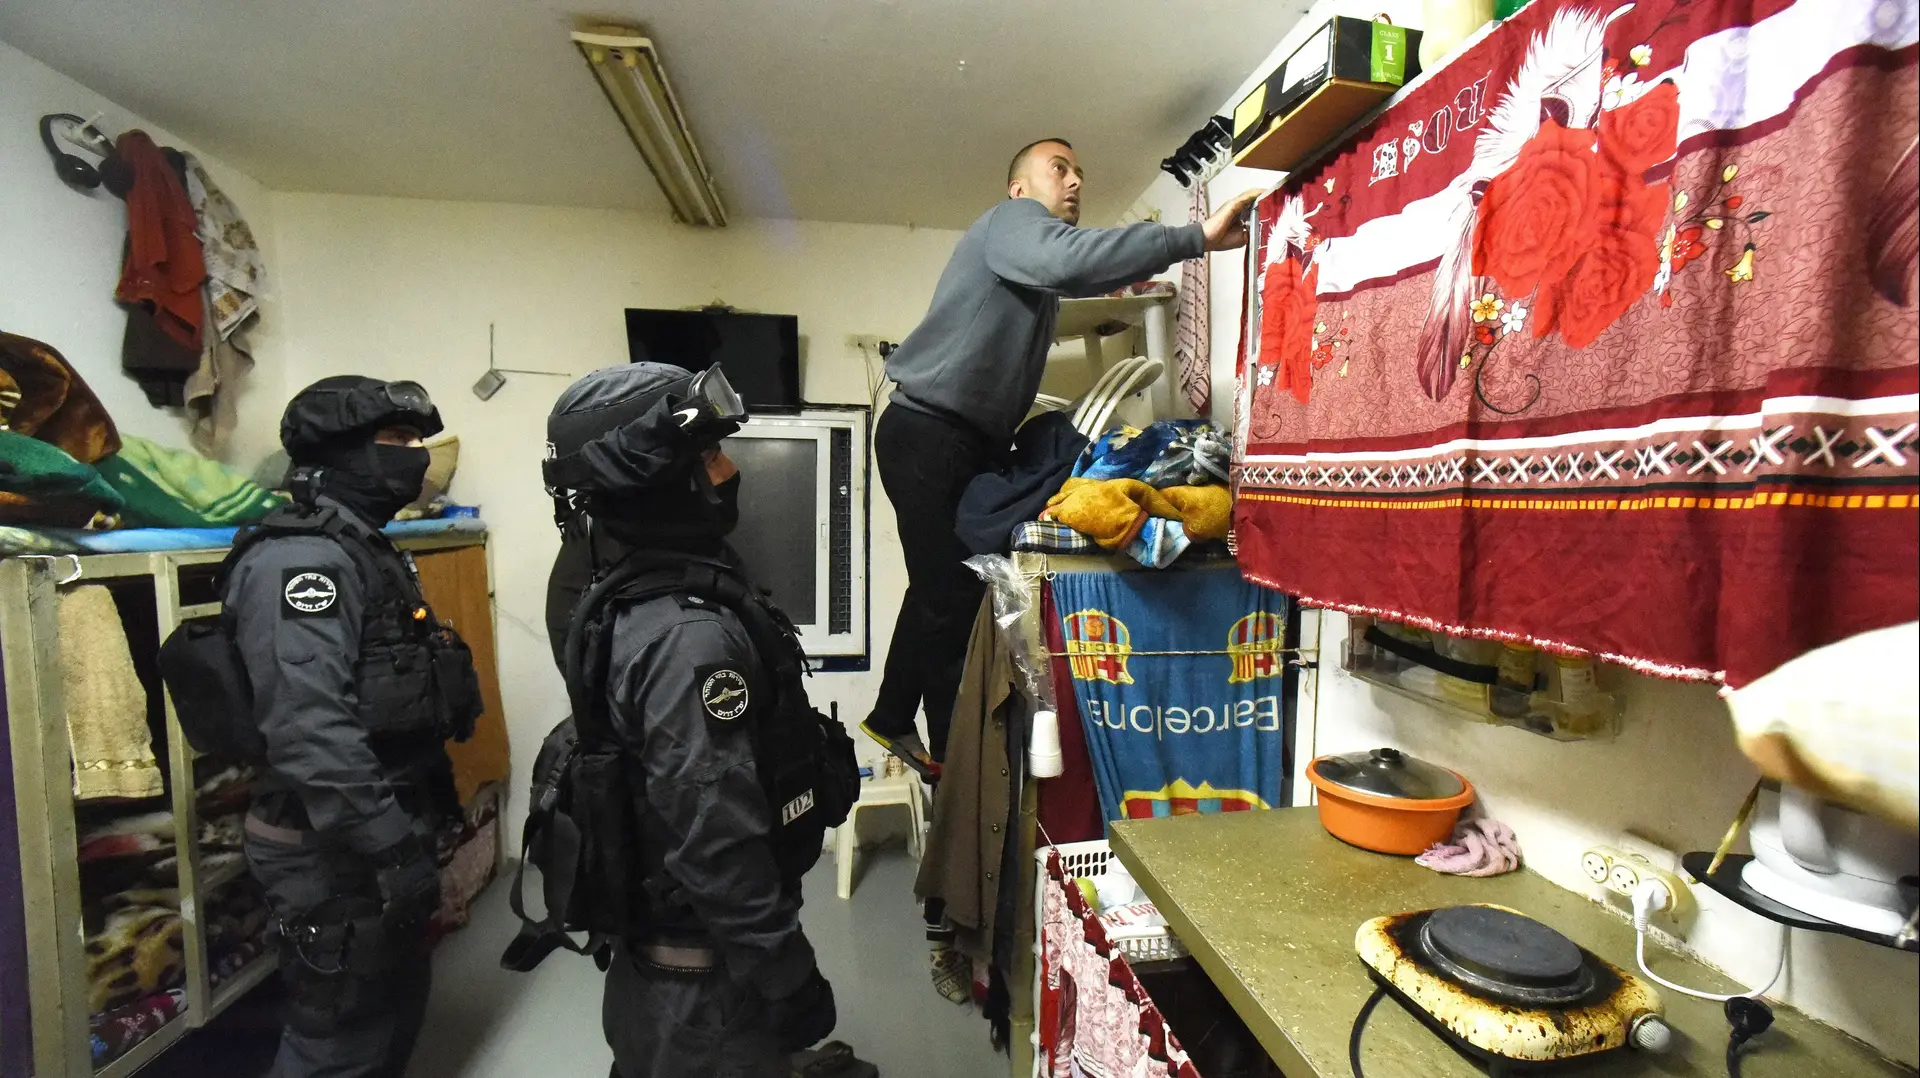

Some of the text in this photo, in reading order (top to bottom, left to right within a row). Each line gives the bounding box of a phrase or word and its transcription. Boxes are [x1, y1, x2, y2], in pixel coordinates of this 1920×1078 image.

[1379, 30, 1400, 38] CLASS
[1385, 44, 1394, 61] 1
[1087, 696, 1280, 740] Barcelona
[783, 789, 813, 824] 102
